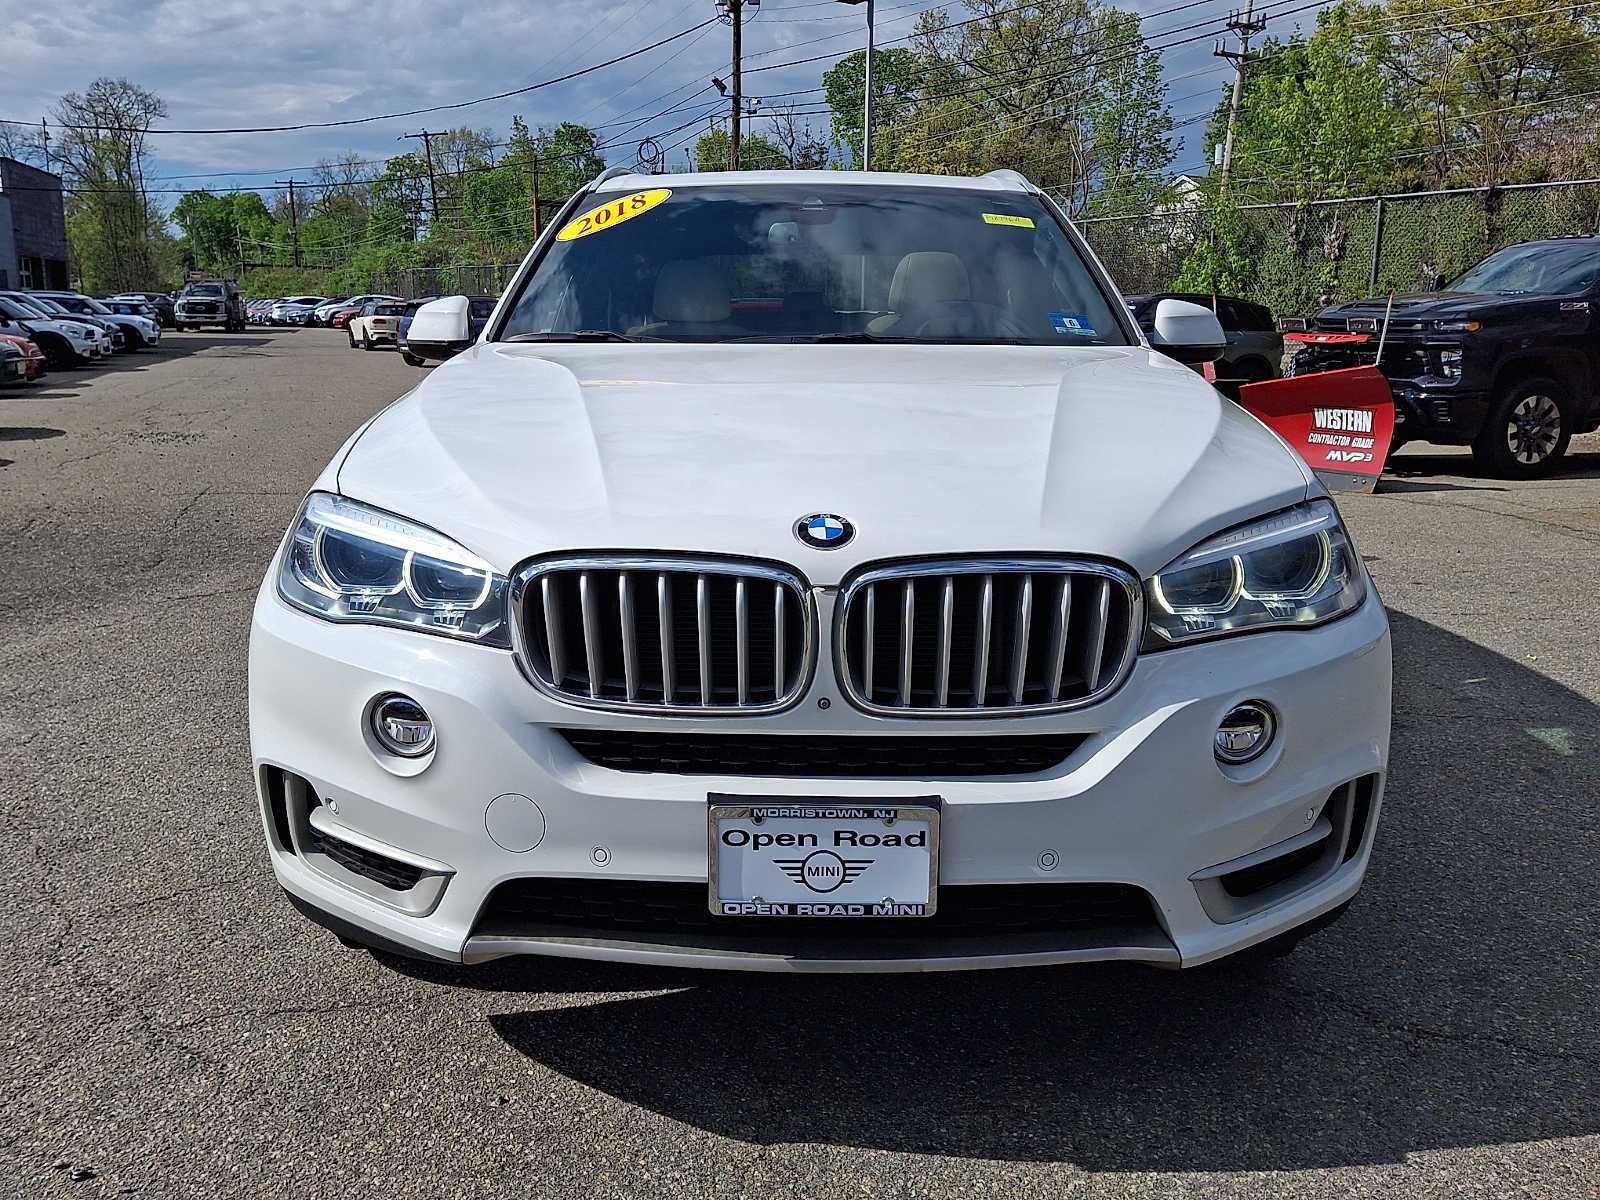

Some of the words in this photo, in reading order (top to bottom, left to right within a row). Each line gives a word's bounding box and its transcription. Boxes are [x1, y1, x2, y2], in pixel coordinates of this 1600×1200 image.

[577, 194, 647, 234] 2018
[1314, 408, 1373, 433] WESTERN
[1308, 433, 1351, 446] CONTRACTOR
[1351, 437, 1375, 449] GRADE
[873, 810, 896, 819] NJ
[721, 829, 818, 851] Open
[833, 830, 926, 847] Road
[807, 866, 841, 877] MINI
[723, 903, 789, 915] OPEN
[797, 904, 865, 916] ROAD
[872, 904, 923, 915] MINI
